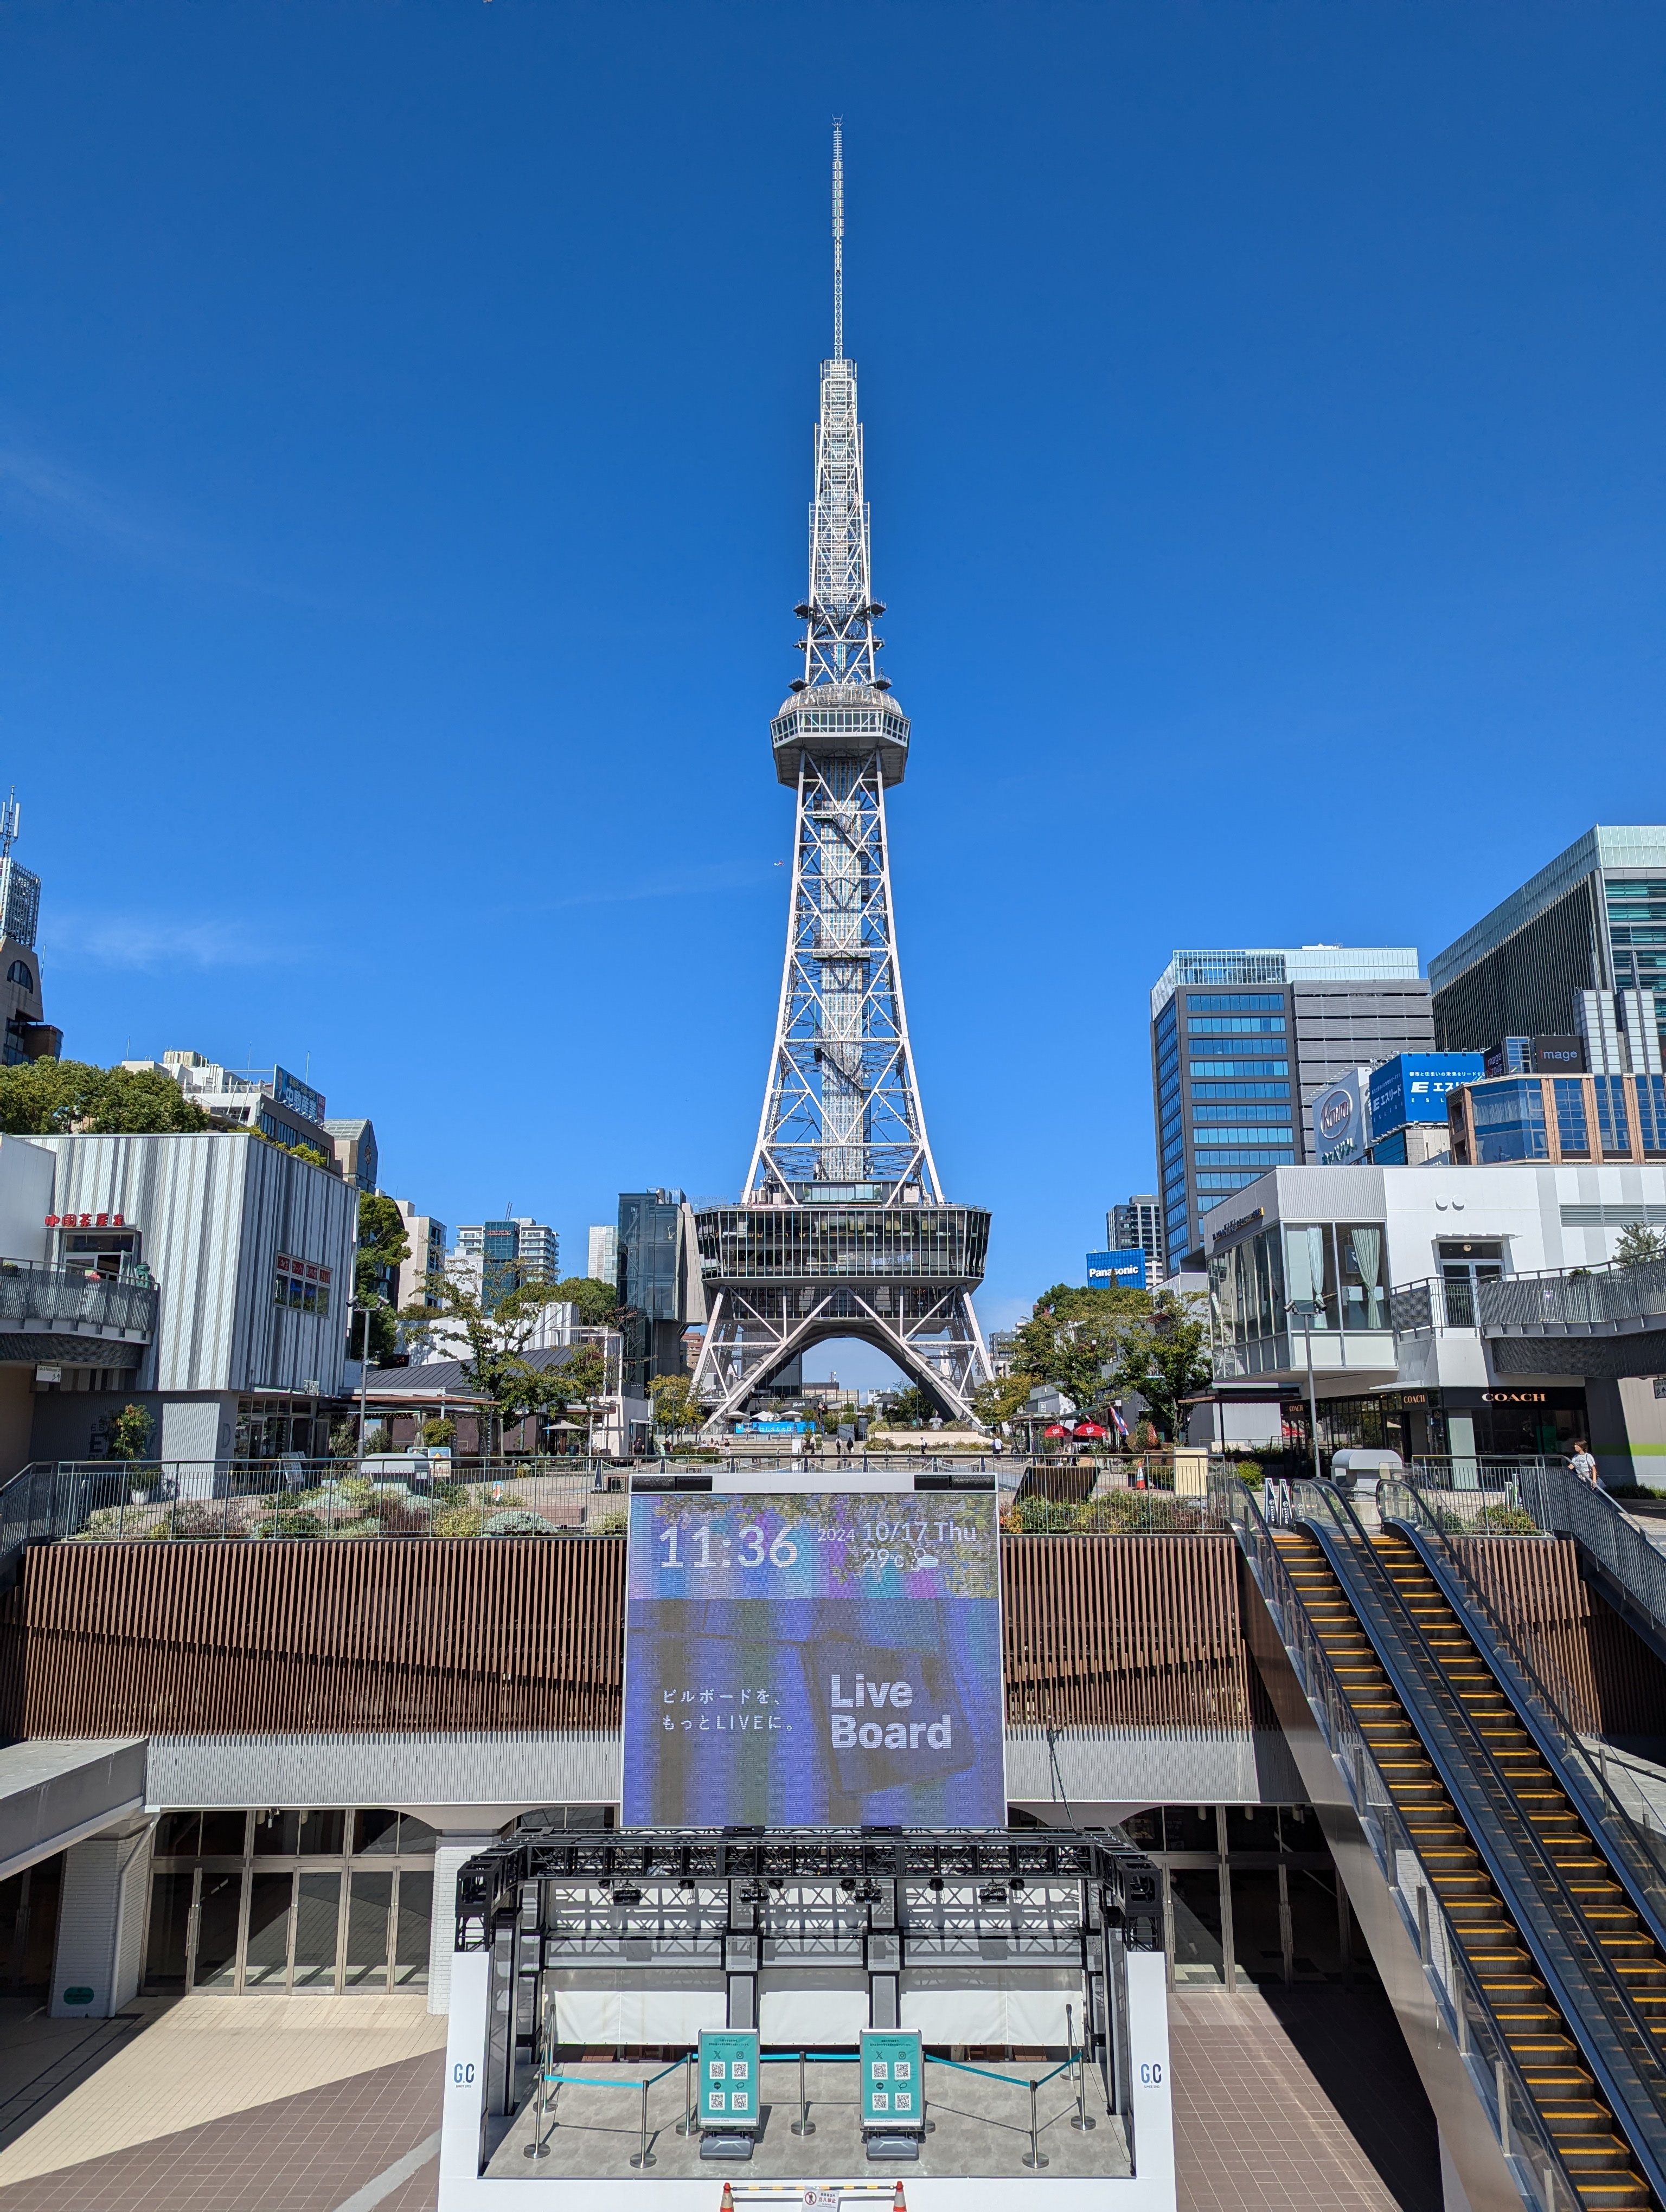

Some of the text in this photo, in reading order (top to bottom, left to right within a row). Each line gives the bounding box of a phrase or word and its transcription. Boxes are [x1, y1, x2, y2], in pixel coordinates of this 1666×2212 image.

[1540, 1049, 1578, 1062] Image
[1403, 1394, 1426, 1404] COACH
[1482, 1393, 1546, 1402] COACH
[818, 1520, 977, 1542] 2024 10/17 Thu
[659, 1524, 798, 1568] 11:36
[663, 1688, 780, 1705] ビルボードを、
[831, 1674, 913, 1707] Live
[663, 1715, 793, 1731] もっとLIVEに。
[831, 1714, 952, 1750] Board
